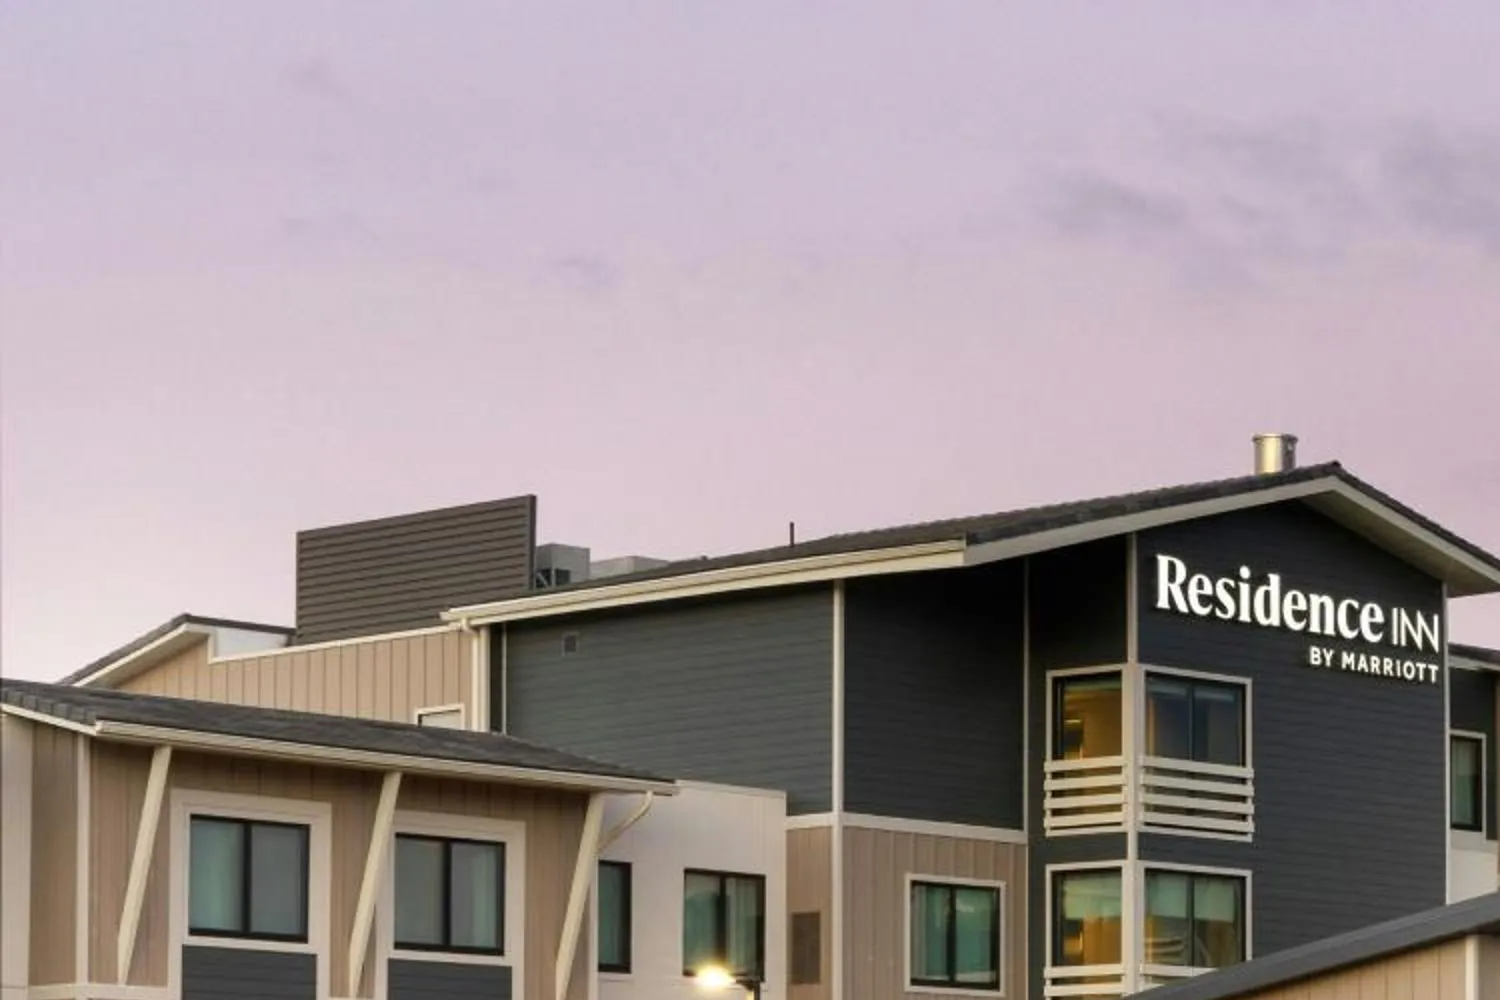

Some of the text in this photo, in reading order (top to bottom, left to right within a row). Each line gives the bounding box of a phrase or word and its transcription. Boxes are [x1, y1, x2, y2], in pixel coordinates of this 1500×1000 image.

[1156, 553, 1440, 654] Residence INN
[1309, 645, 1440, 684] BY MARRIOTT
